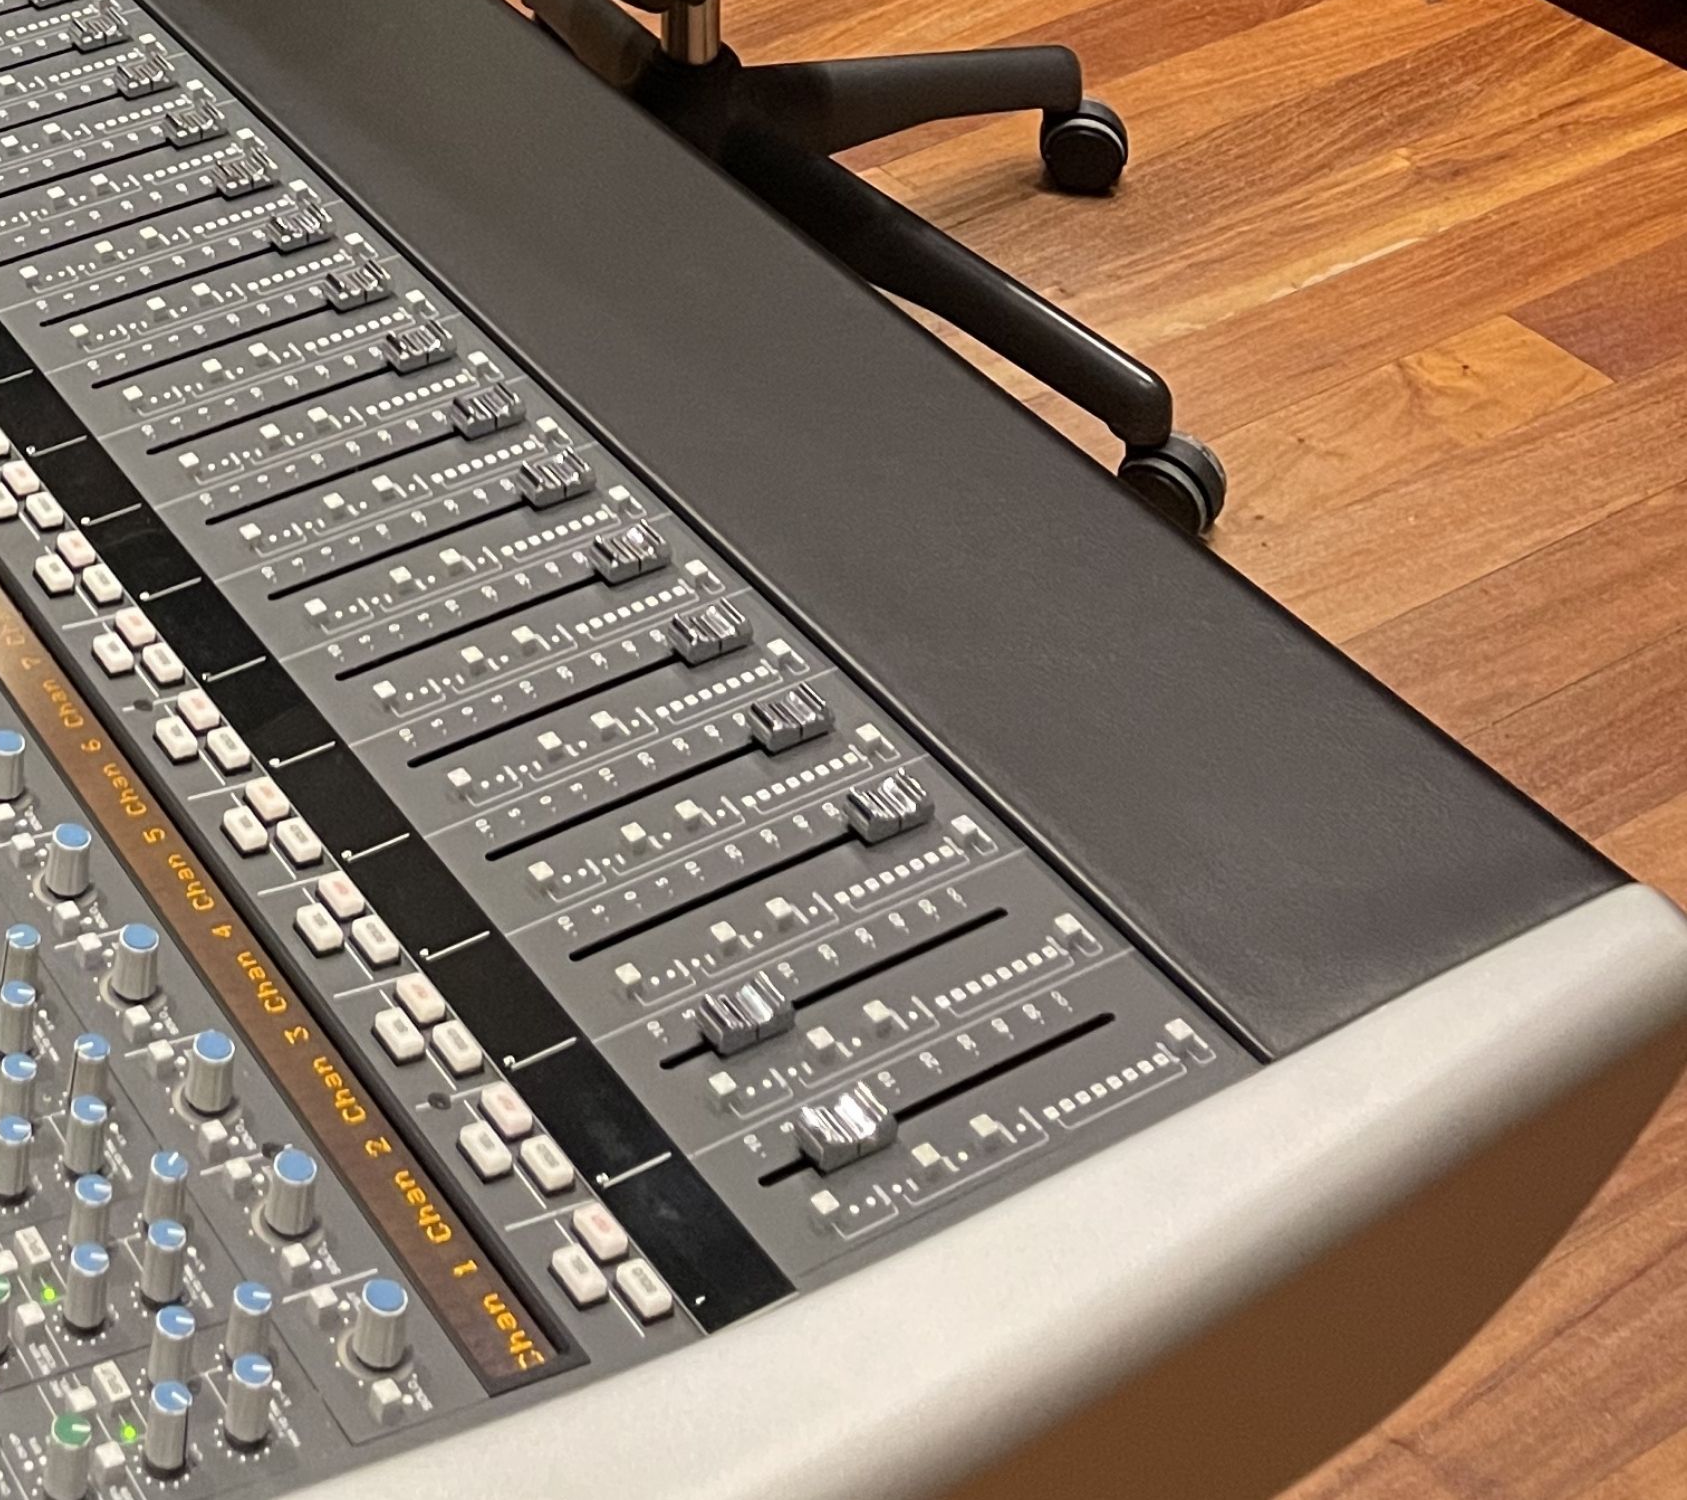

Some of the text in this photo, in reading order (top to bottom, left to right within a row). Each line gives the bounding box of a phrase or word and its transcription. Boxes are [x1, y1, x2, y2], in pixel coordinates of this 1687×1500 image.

[43, 680, 83, 728] Chan
[81, 738, 101, 752] 6
[104, 765, 146, 817] Chan
[143, 828, 165, 844] 5
[169, 855, 213, 910] Chan
[212, 925, 232, 938] 4
[238, 952, 286, 1012] Chan
[284, 1026, 309, 1044] 3
[314, 1058, 365, 1123] Chan
[364, 1137, 392, 1157] 2
[396, 1172, 451, 1243] Chan
[453, 1260, 477, 1277] 1
